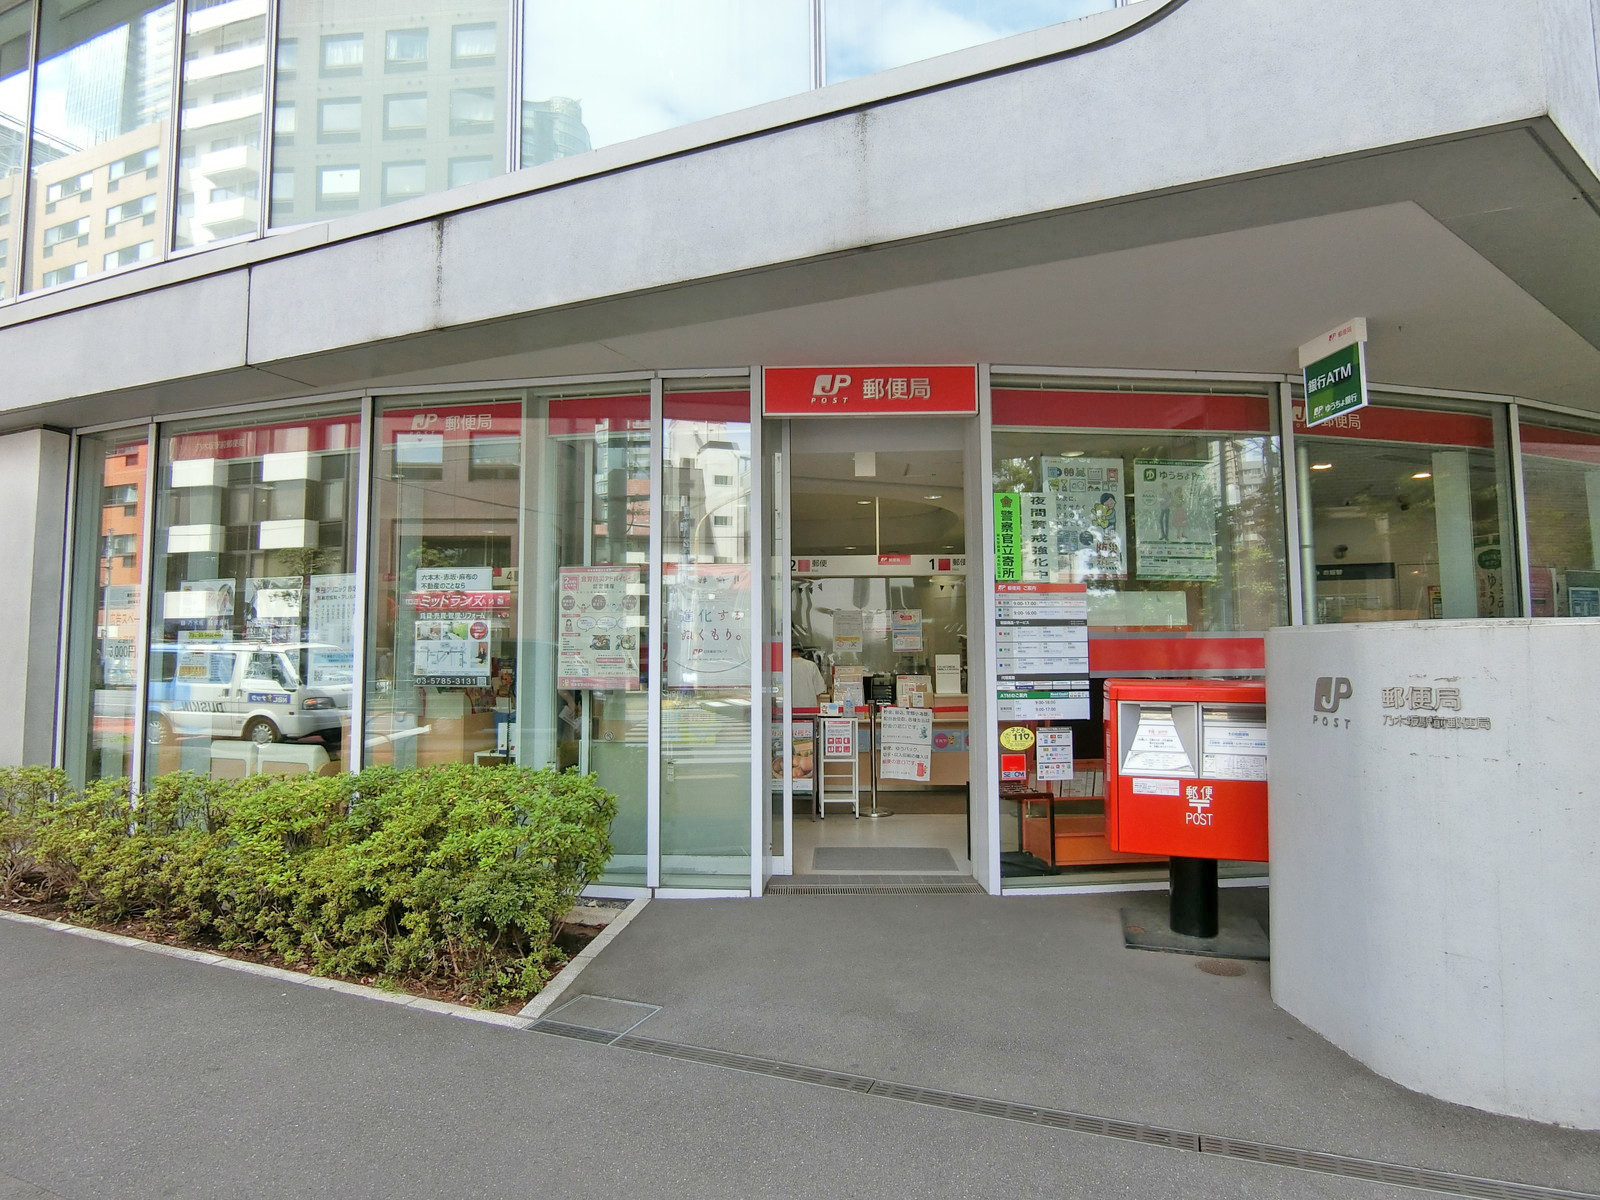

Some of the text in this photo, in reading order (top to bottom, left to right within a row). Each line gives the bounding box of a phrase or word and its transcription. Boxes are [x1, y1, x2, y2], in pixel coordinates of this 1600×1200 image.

[812, 374, 931, 400] JP 郵便局
[1308, 363, 1352, 394] 銀行ATM
[1325, 393, 1357, 413] ゆうちょ銀行
[445, 413, 493, 432] 郵便局
[1000, 510, 1015, 579] 警察官立寄所
[1030, 496, 1049, 580] 夜間警戒強化中
[811, 559, 828, 568] 郵便
[929, 558, 935, 570] 1
[506, 571, 512, 580] 4
[420, 595, 486, 607] ミッドランズ
[1488, 573, 1497, 617] ゆう
[416, 677, 476, 685] 03-5785-3131
[1314, 677, 1353, 713] JP
[1381, 686, 1462, 712] 郵便局
[1312, 714, 1351, 730] POST
[1382, 714, 1492, 731] 乃木坂駅前郵便局
[1185, 786, 1213, 801] 郵便
[1185, 812, 1213, 826] POST
